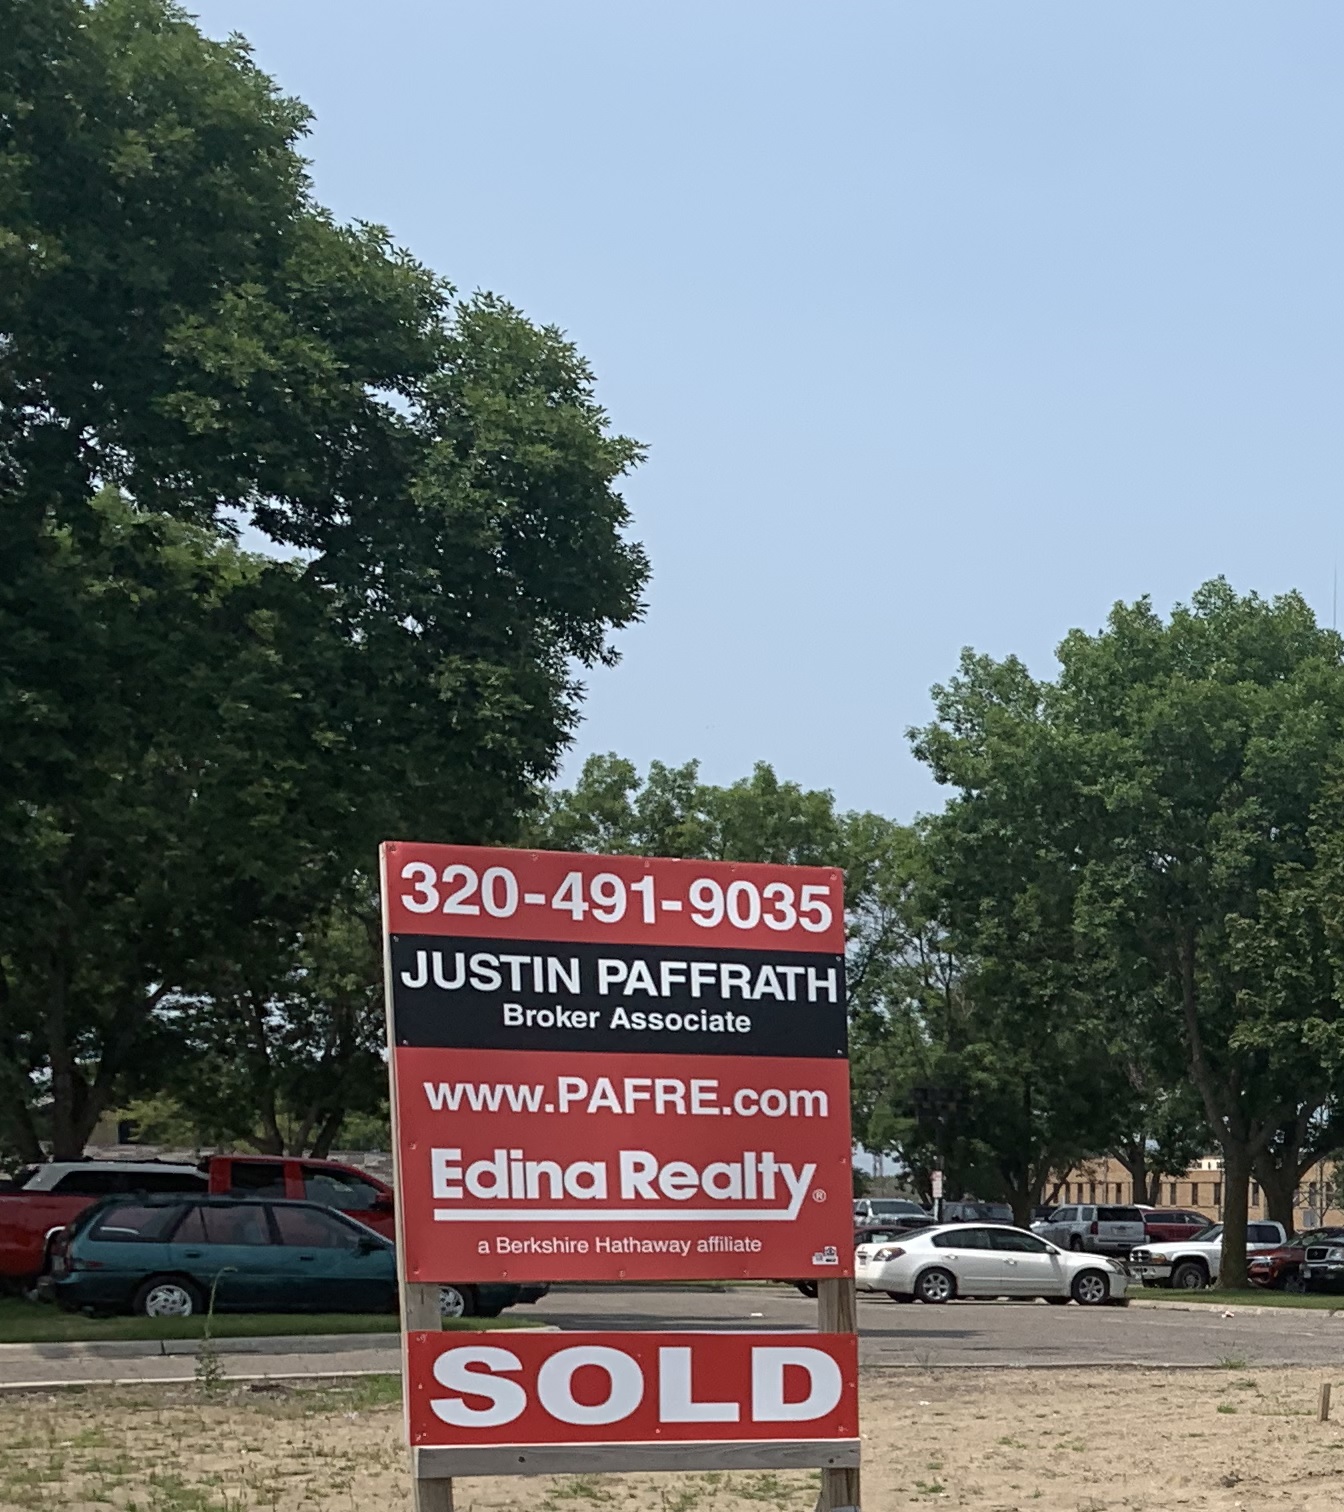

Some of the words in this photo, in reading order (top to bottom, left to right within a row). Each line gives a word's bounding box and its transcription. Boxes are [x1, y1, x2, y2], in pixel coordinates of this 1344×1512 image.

[400, 862, 832, 932] 320-491-9035
[400, 950, 581, 994] JUSTIN
[598, 958, 837, 1003] PAFFRATH
[503, 1003, 600, 1029] Broker
[609, 1006, 751, 1033] Associate
[423, 1076, 829, 1117] www.PAFRE.com
[430, 1147, 608, 1200] Edina
[477, 1240, 491, 1254] a
[496, 1236, 589, 1254] Berkshire
[595, 1236, 692, 1257] Hathaway
[696, 1235, 762, 1253] affiliate
[429, 1346, 843, 1428] SOLD
